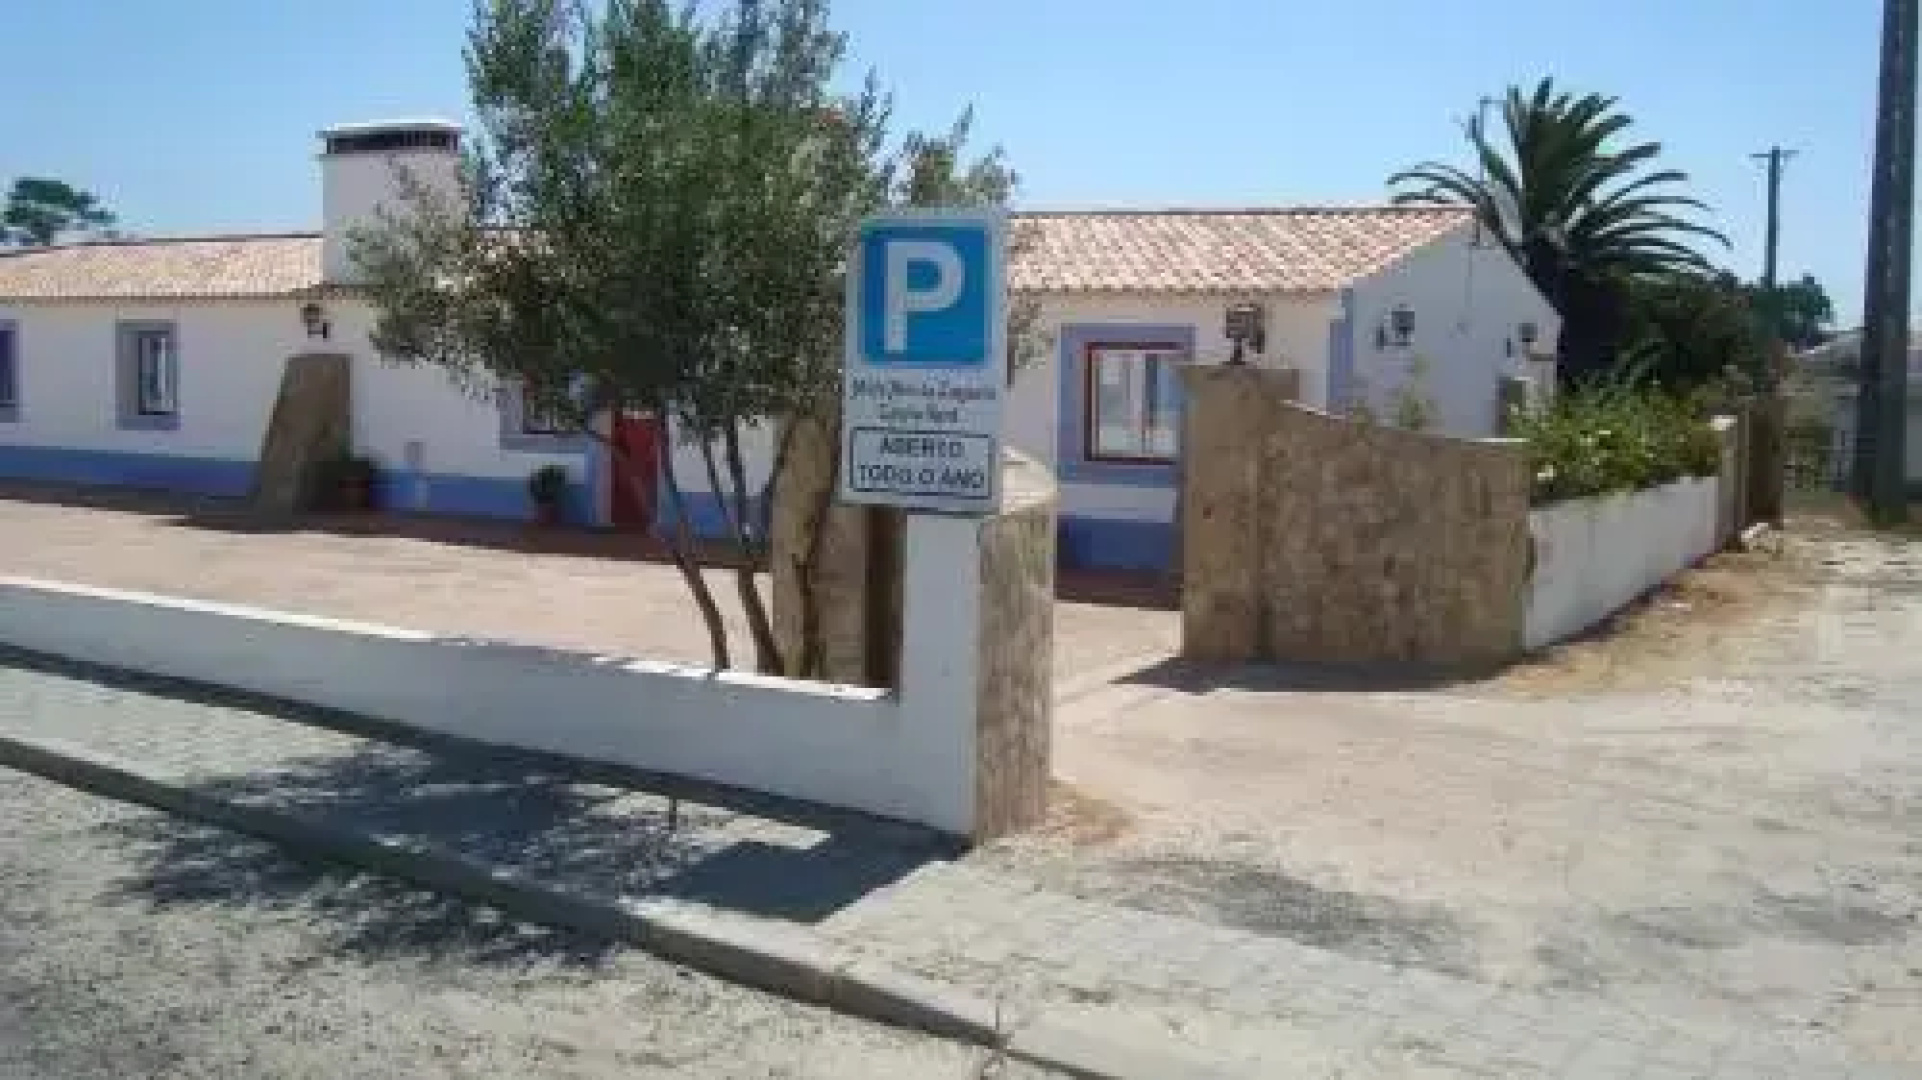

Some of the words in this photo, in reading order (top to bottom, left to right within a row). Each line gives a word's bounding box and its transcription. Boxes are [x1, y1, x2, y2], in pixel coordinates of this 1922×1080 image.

[884, 240, 965, 353] P
[858, 464, 913, 486] TODO
[917, 467, 936, 486] O
[940, 467, 986, 490] ANO
